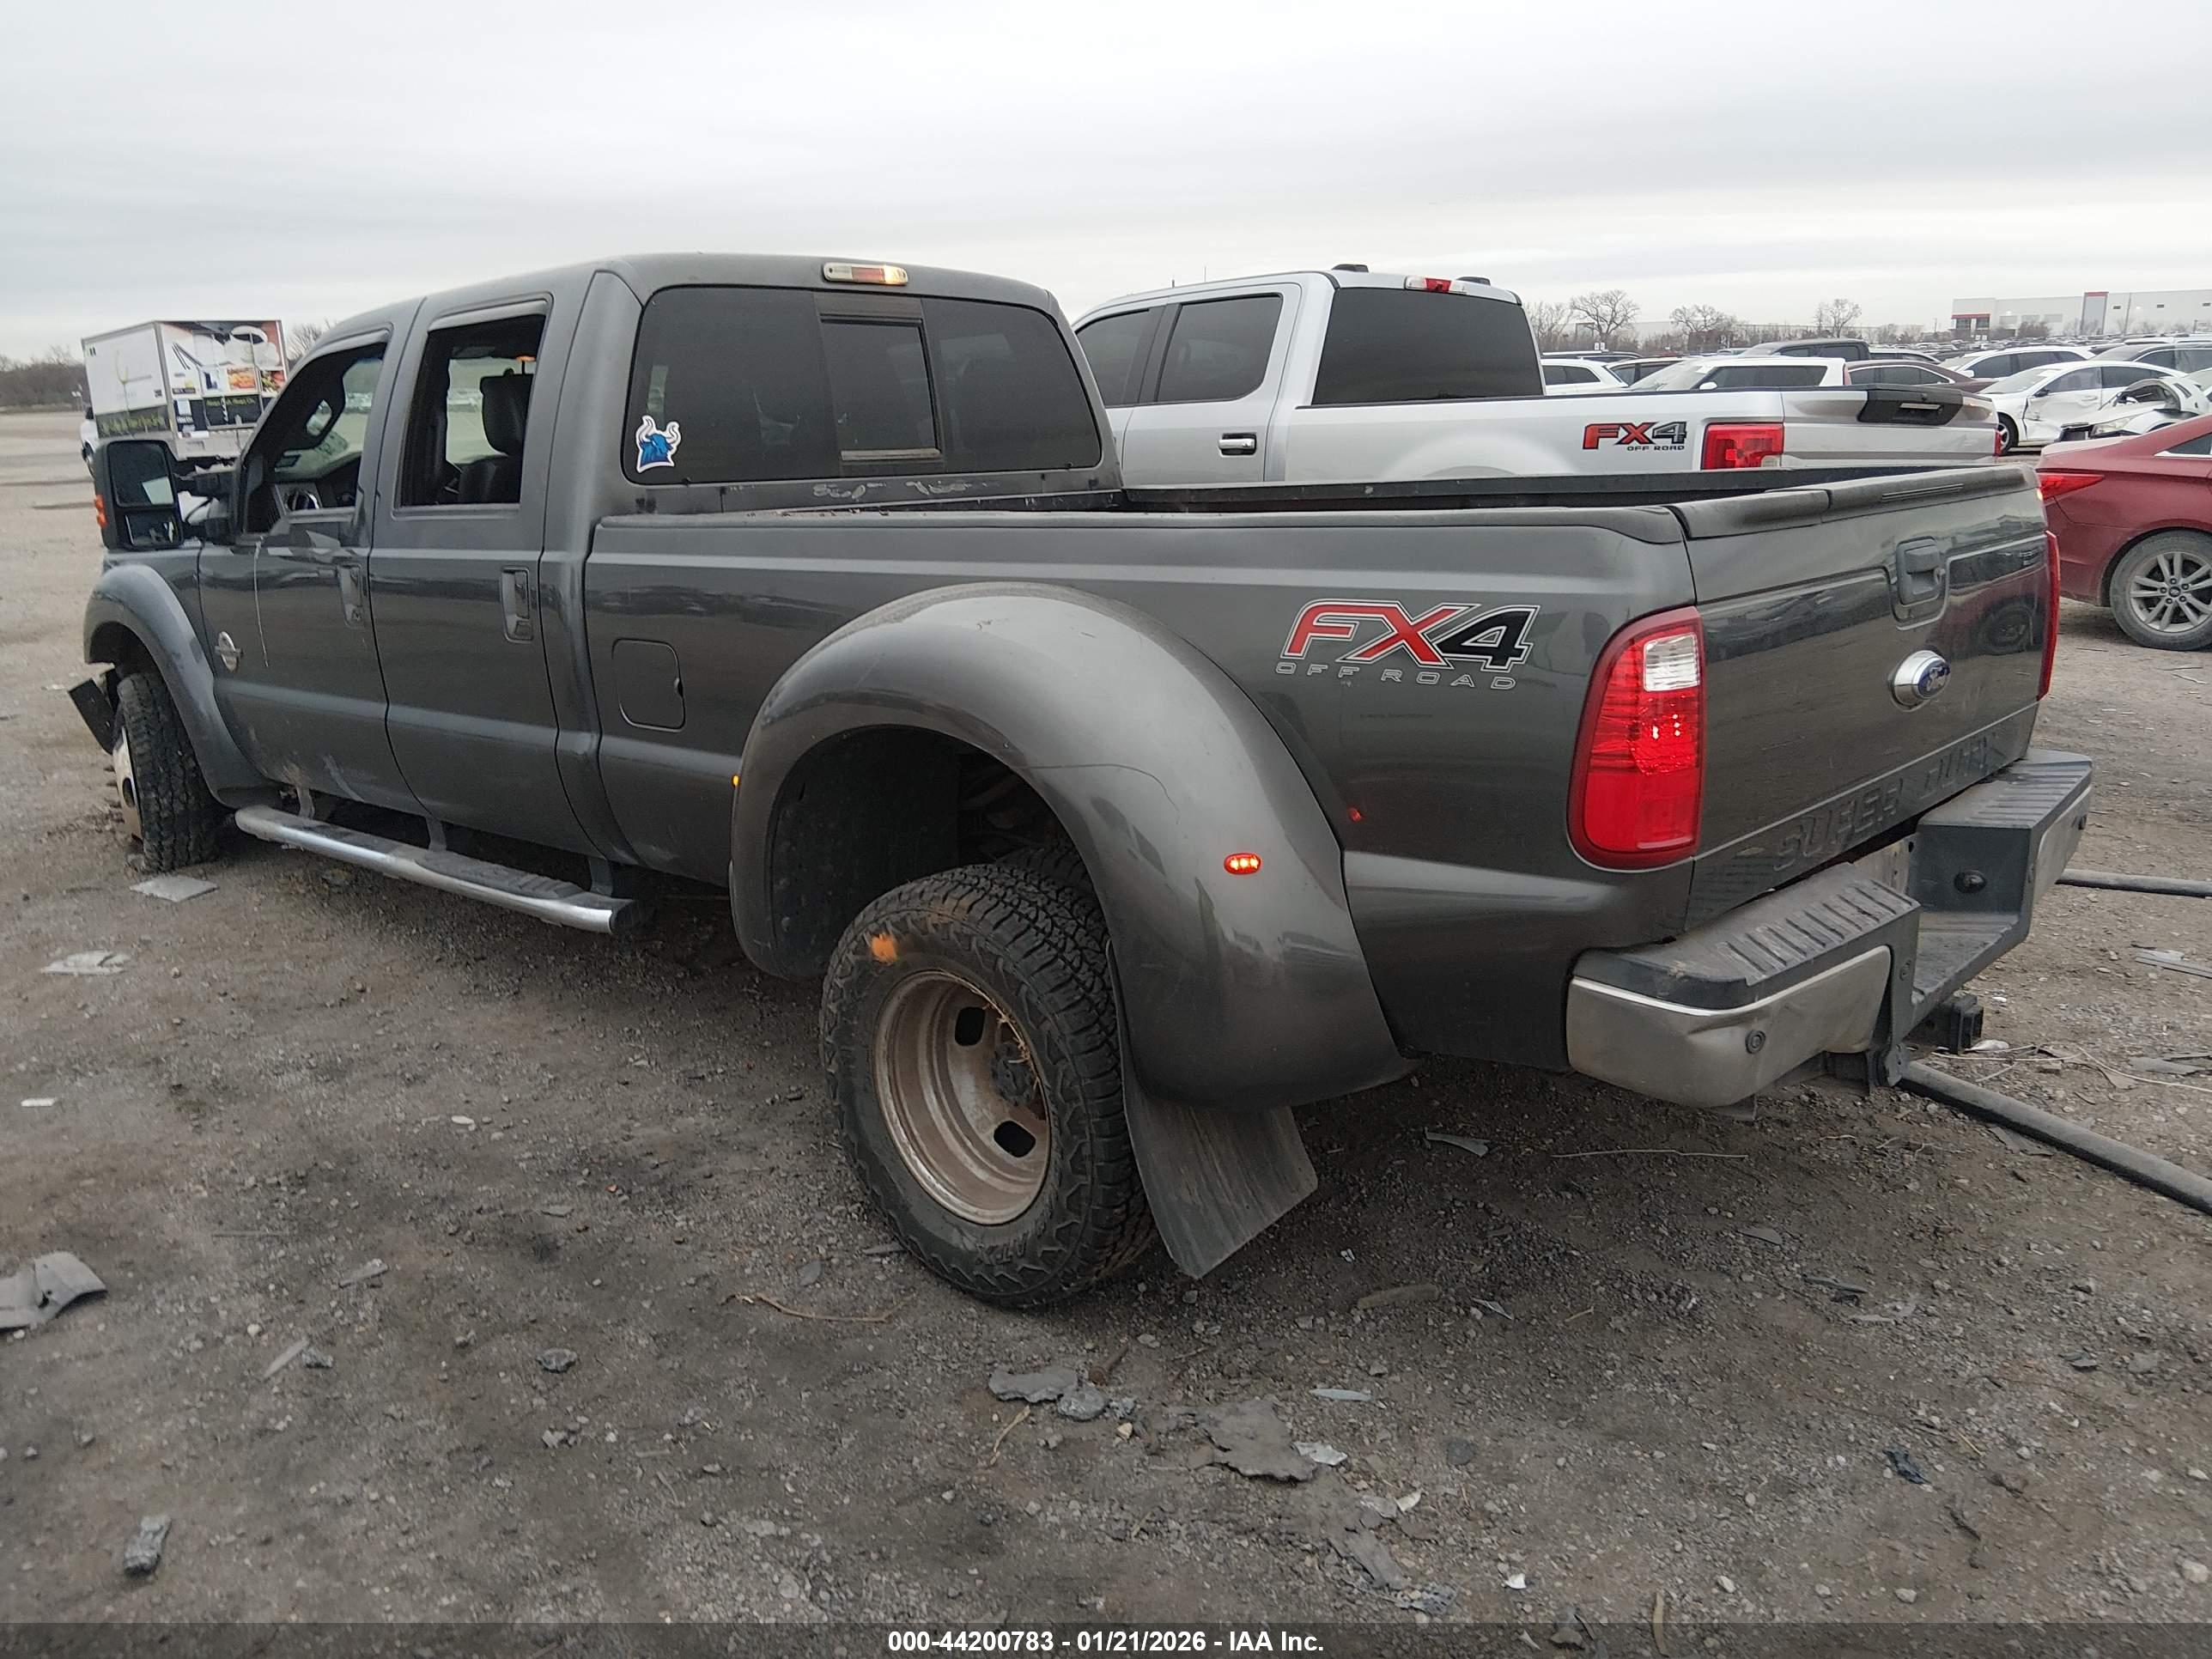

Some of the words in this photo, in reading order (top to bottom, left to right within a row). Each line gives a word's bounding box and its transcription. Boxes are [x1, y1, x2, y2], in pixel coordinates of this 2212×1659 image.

[1583, 421, 1686, 449] FX4
[1279, 598, 1540, 673] FX4
[1275, 662, 1360, 679] OFF
[1380, 669, 1516, 690] ROAD
